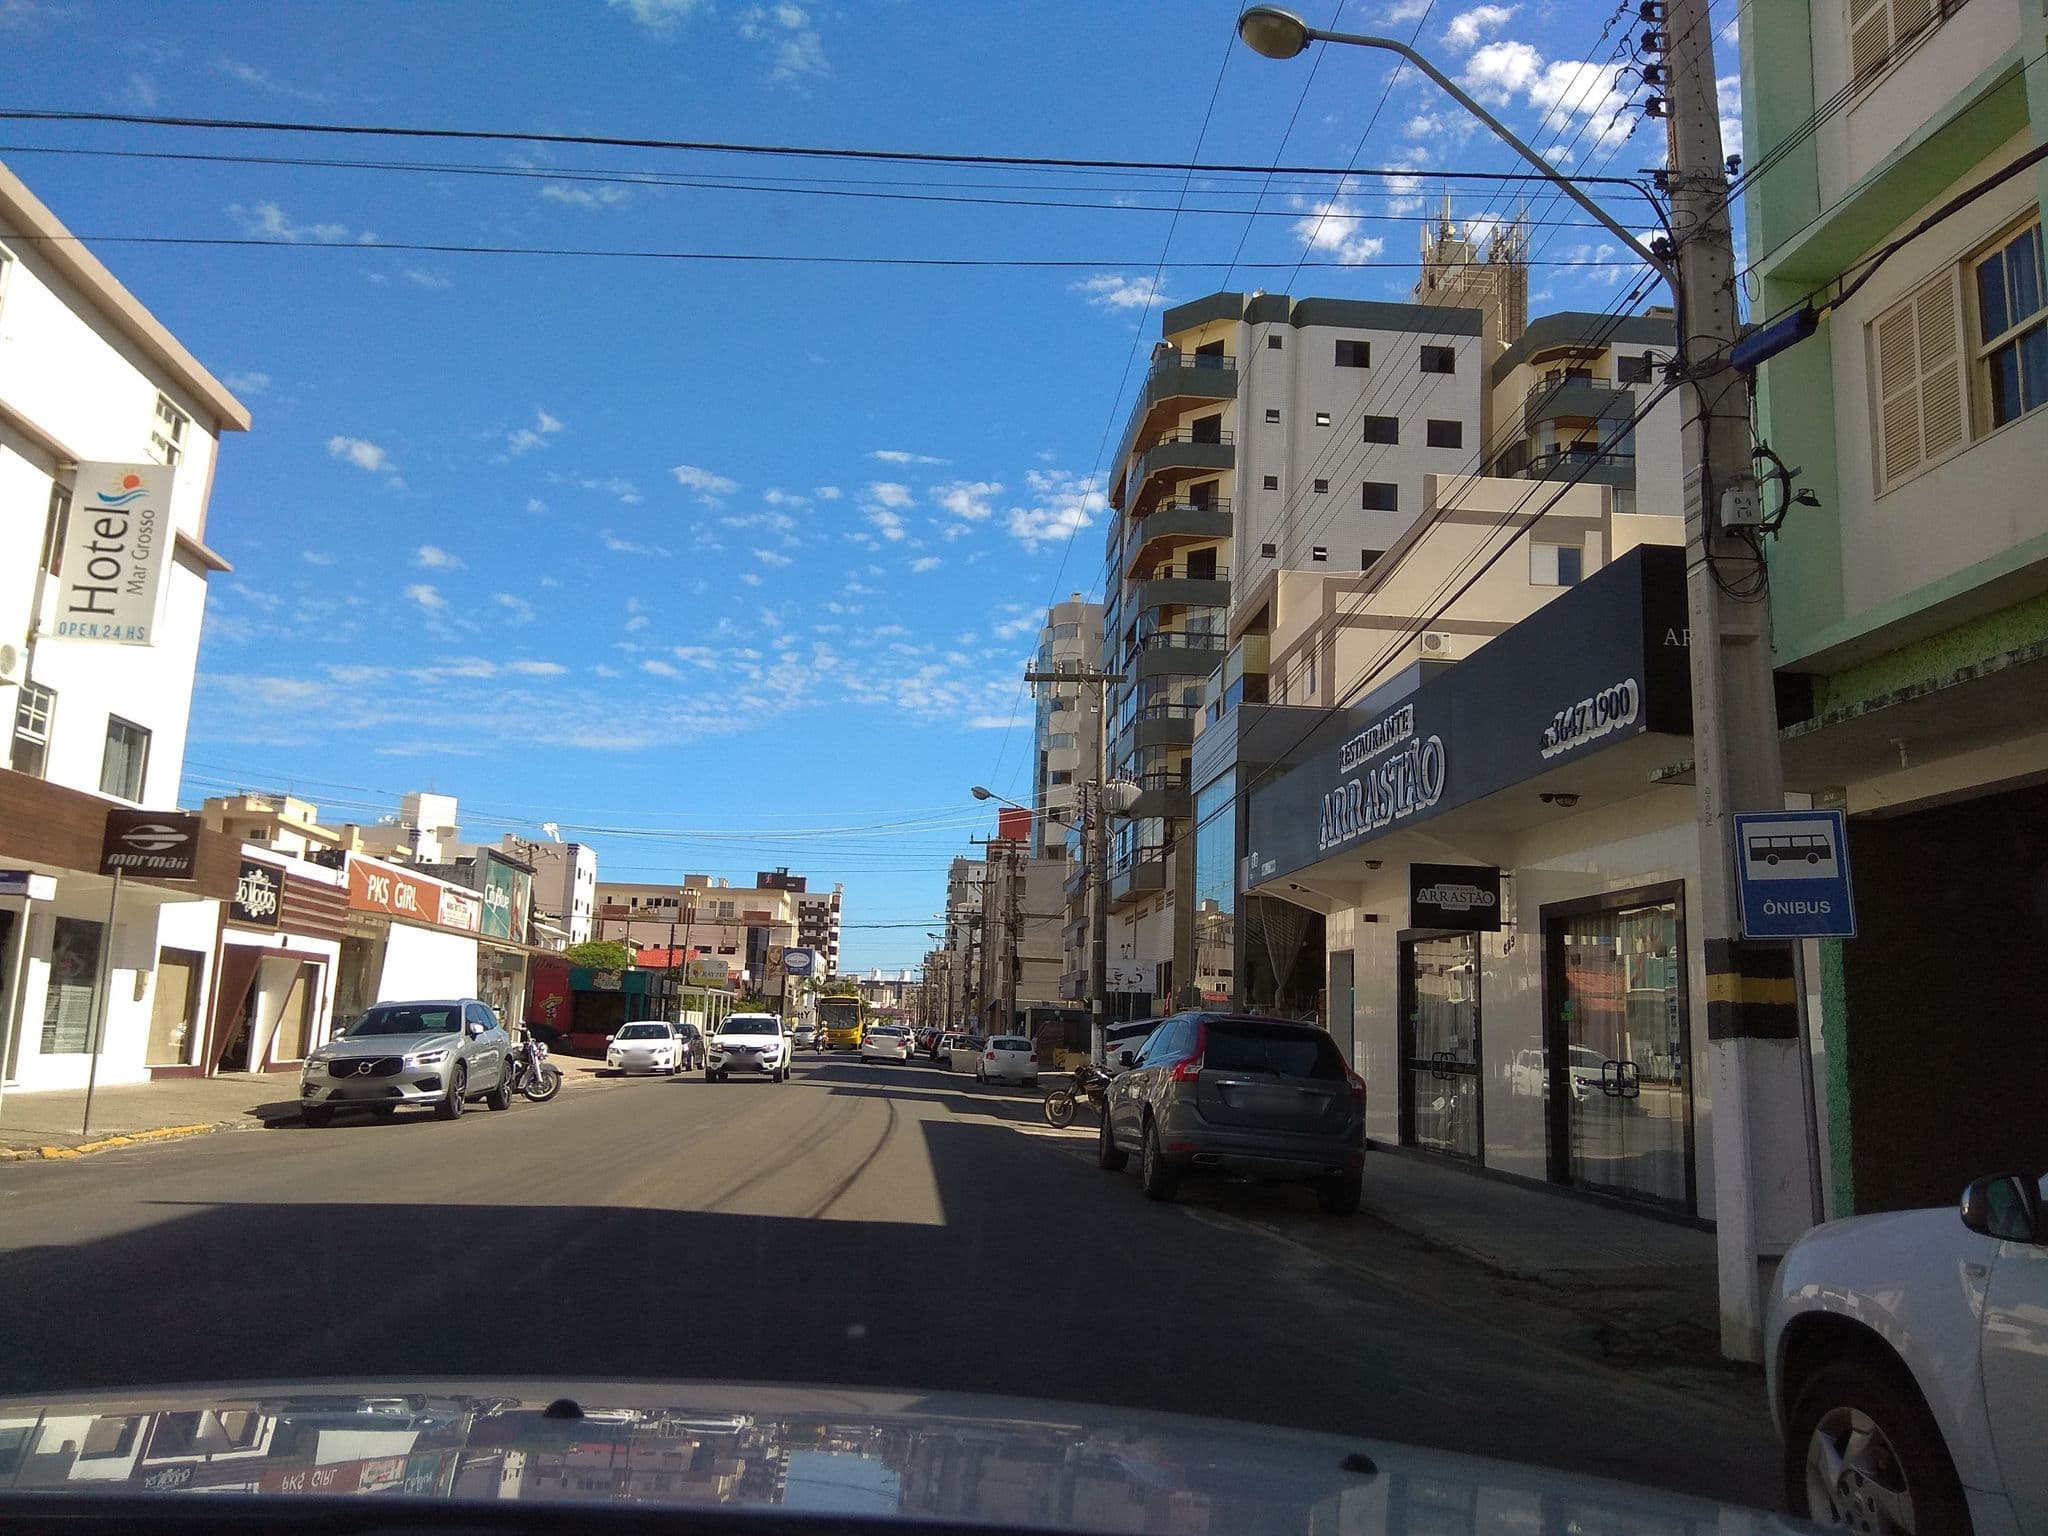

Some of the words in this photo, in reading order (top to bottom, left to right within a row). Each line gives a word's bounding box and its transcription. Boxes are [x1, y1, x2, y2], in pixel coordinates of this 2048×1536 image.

[131, 509, 155, 561] Grosso
[69, 506, 130, 616] Hotel
[126, 569, 149, 596] Mar
[58, 621, 97, 637] OPEN
[103, 624, 121, 638] 24
[126, 625, 145, 640] HS
[1338, 703, 1414, 774] RESTAURANTE
[1319, 734, 1446, 851] ARRASTÃO
[107, 852, 189, 871] mormaii
[367, 873, 389, 905] PKS
[394, 882, 418, 912] GIRL
[1418, 888, 1495, 906] ARRASTÃO
[1762, 898, 1831, 916] ÔNIBUS
